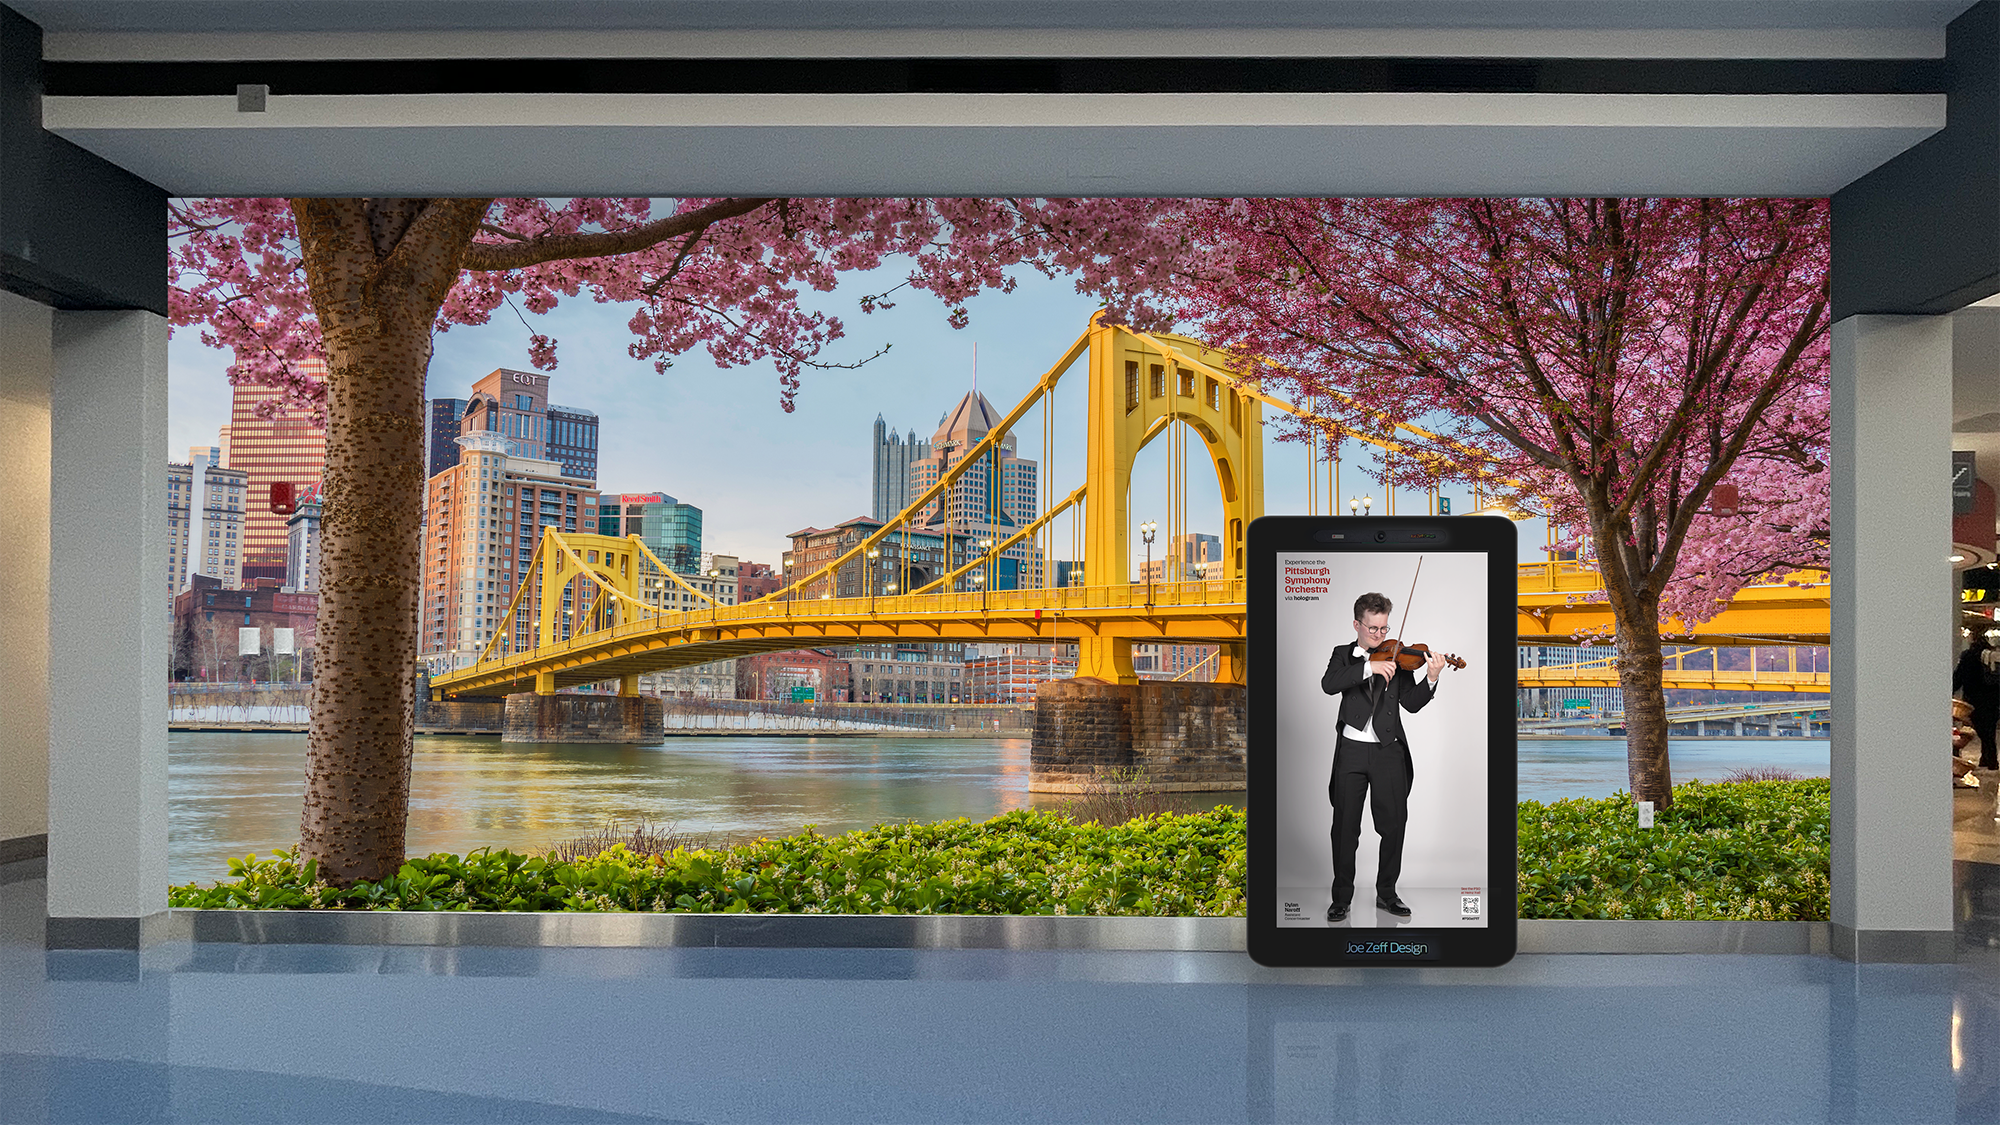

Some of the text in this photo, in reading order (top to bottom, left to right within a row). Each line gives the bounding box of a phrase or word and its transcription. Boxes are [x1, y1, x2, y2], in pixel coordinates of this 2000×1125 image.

[513, 373, 538, 385] EQT
[622, 494, 661, 503] Reed Smith
[1284, 567, 1331, 576] Pittsburgh
[1284, 576, 1331, 585] Symphony
[1284, 585, 1329, 594] Orchestra
[1346, 941, 1428, 956] Joe Zeff Design
